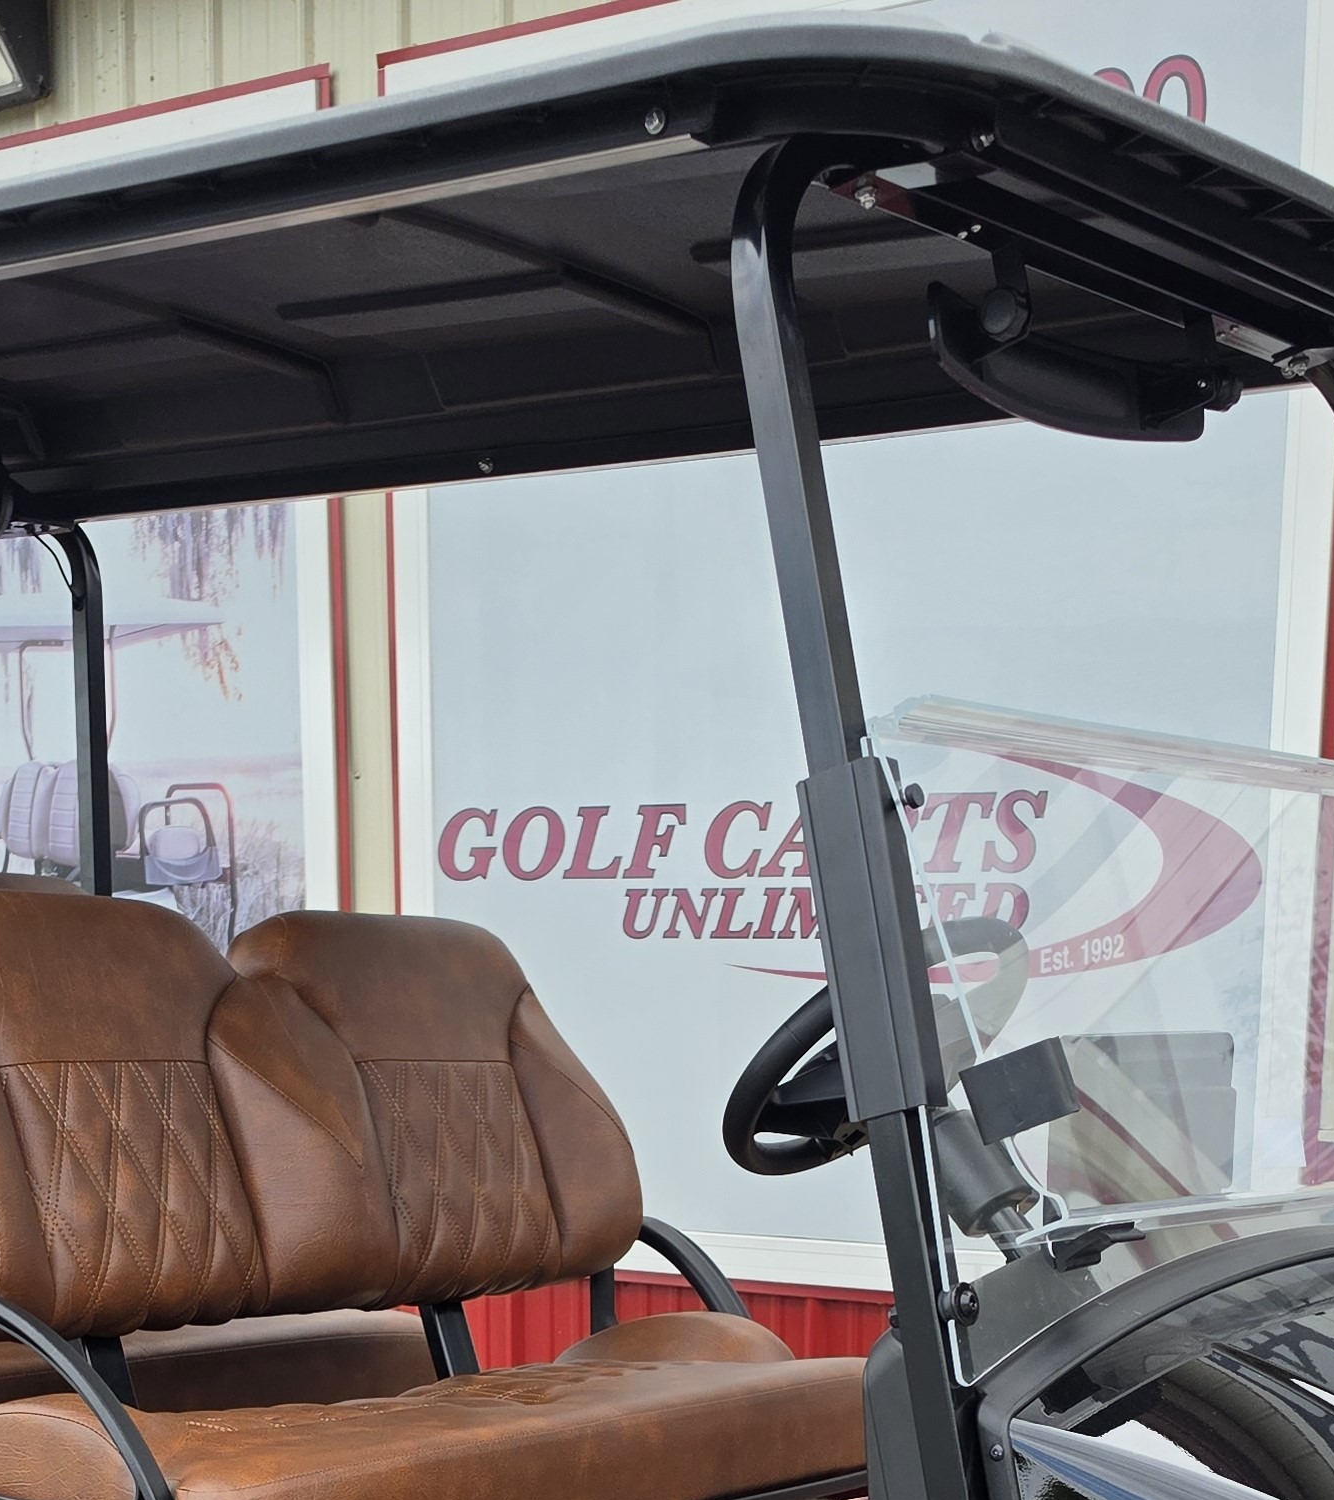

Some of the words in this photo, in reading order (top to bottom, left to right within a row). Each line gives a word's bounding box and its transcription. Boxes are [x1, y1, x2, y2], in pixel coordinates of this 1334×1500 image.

[437, 804, 687, 883] GOLF
[1040, 945, 1074, 974] Est.
[1081, 933, 1125, 966] 1992
